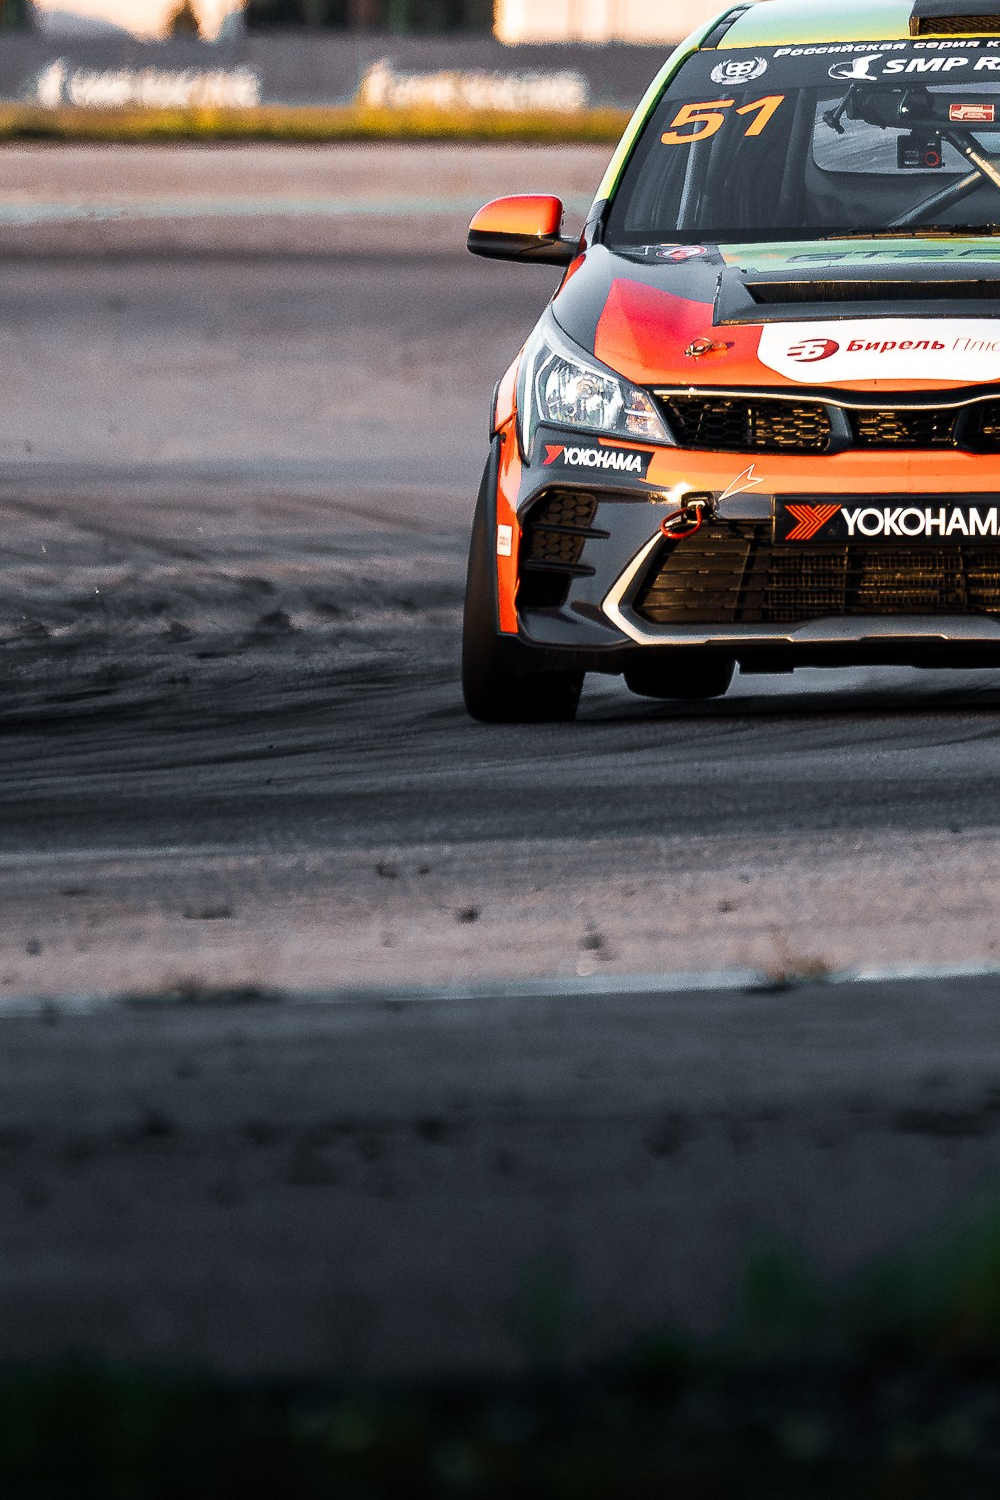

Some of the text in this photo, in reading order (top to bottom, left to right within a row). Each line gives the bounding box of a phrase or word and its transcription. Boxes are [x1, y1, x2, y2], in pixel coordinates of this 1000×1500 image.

[773, 41, 906, 58] Российская
[913, 40, 980, 50] серия
[882, 56, 969, 74] SMP
[660, 94, 785, 145] 51
[846, 339, 945, 354] Бирель
[563, 446, 642, 473] YOKOHAMA
